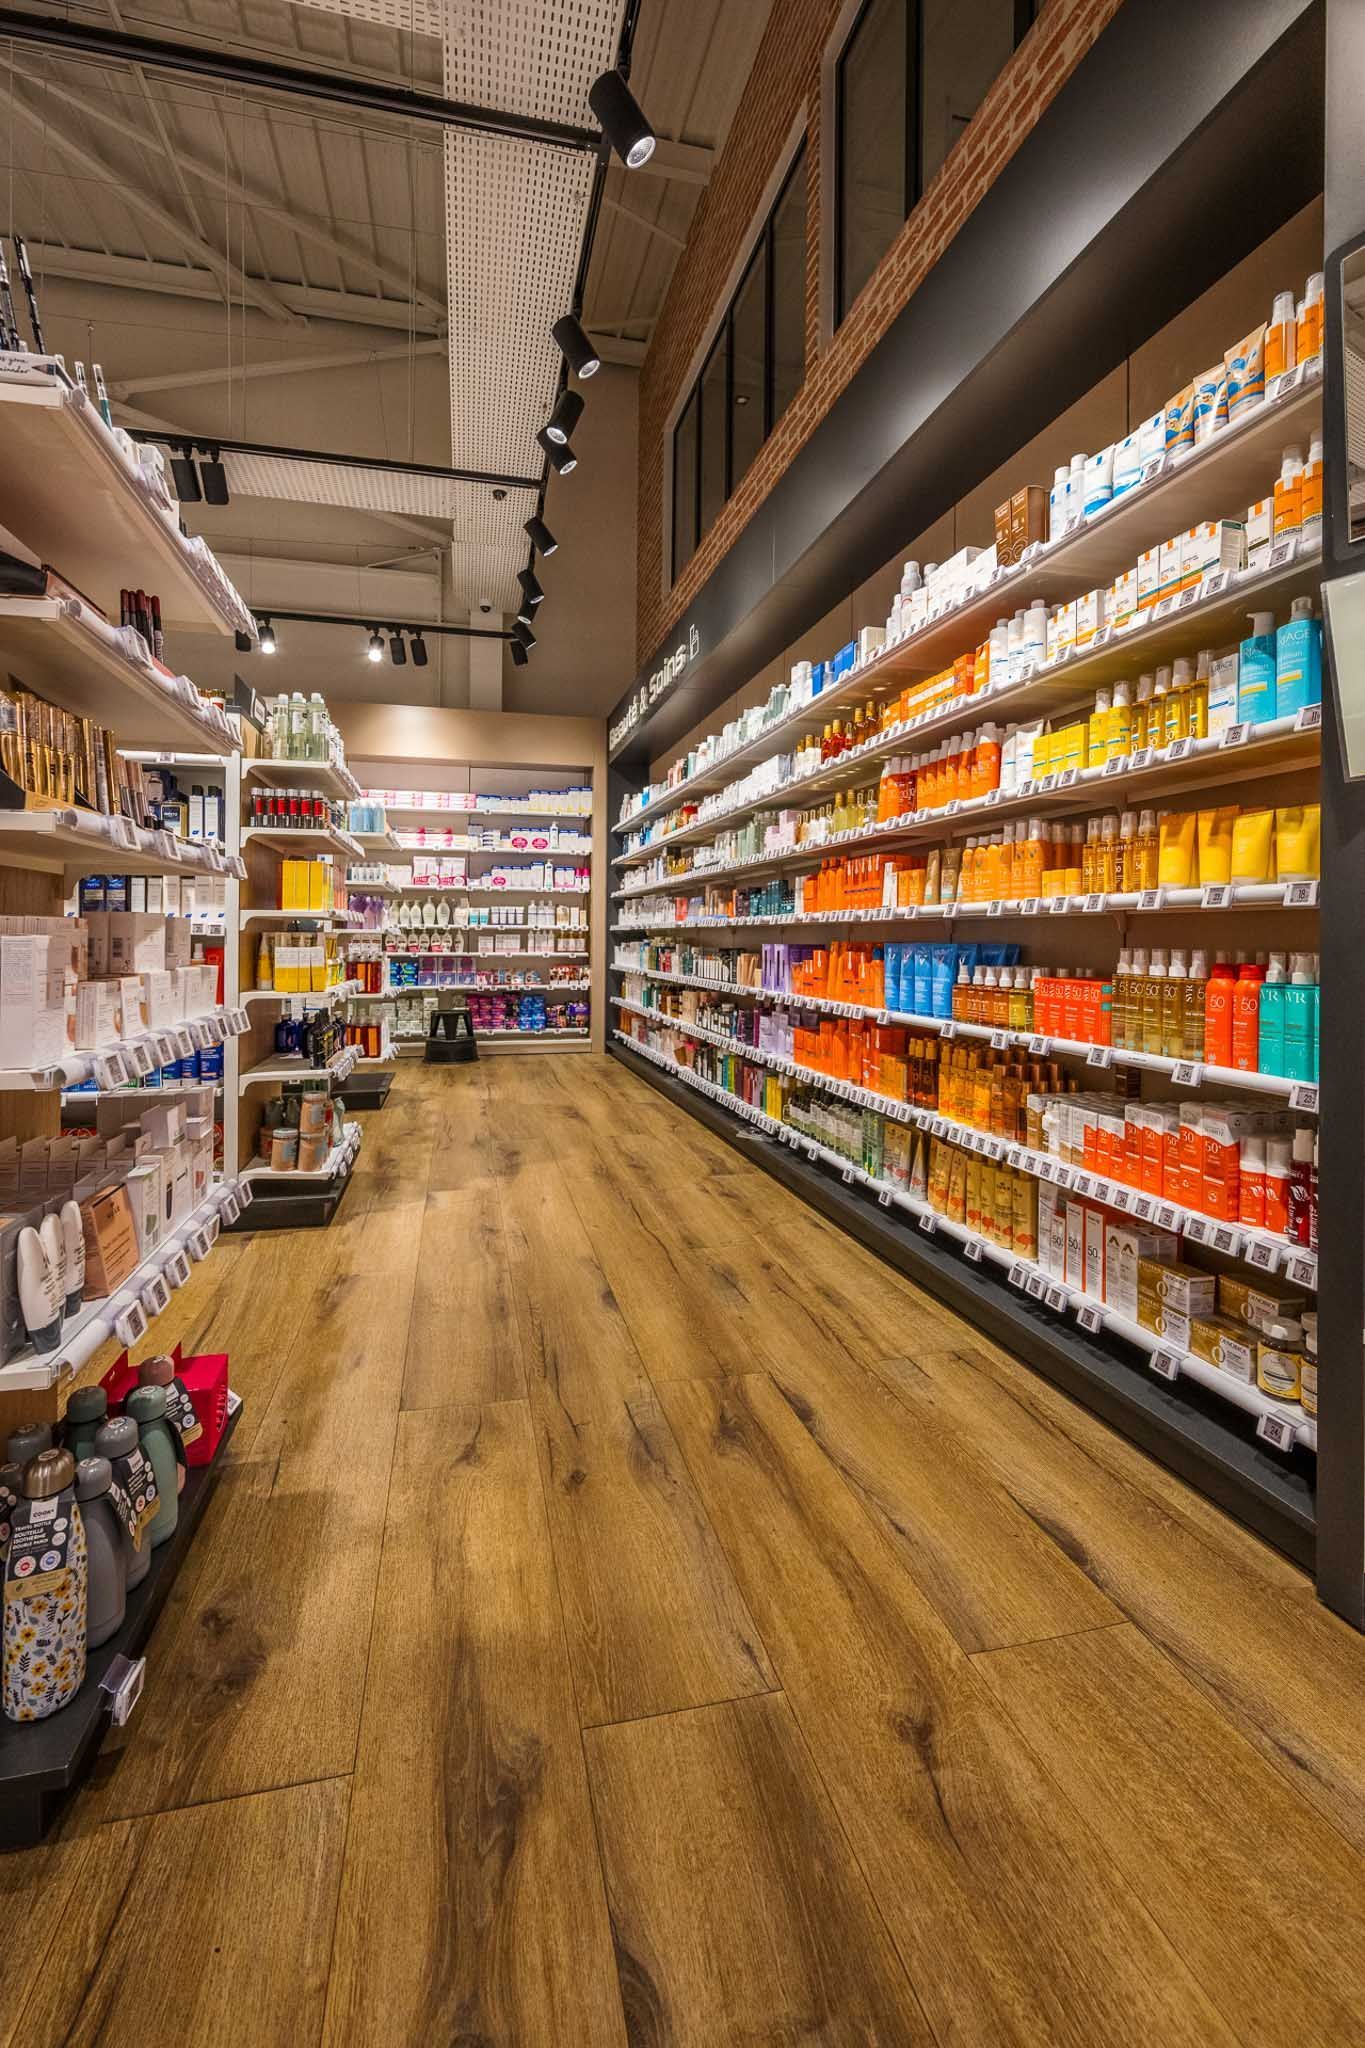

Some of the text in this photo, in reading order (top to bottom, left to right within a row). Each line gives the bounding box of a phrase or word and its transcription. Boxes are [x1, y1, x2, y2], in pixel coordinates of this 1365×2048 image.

[639, 686, 649, 715] &
[648, 643, 687, 704] Soins
[13, 1533, 46, 1545] ISOTHERME
